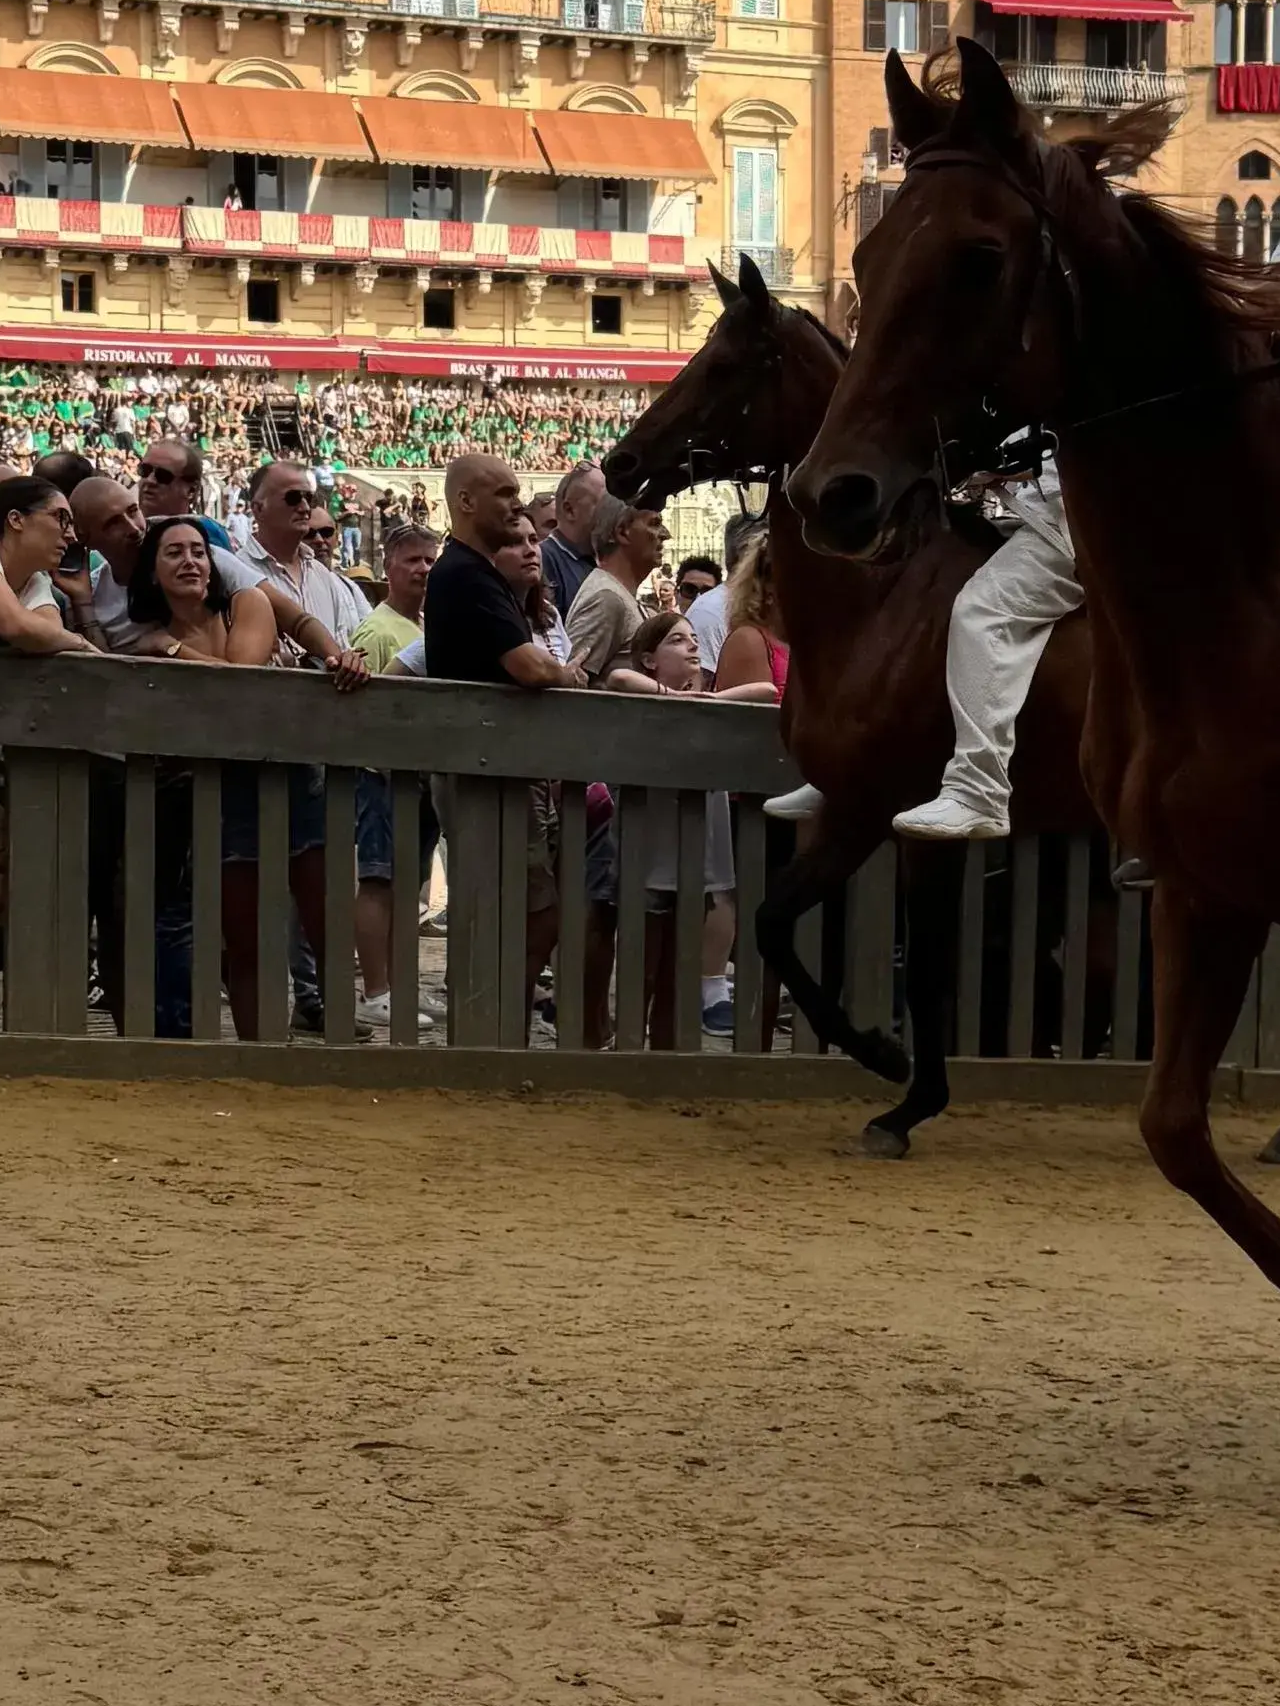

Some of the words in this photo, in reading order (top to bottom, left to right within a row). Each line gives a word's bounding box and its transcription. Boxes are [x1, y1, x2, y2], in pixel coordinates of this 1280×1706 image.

[84, 348, 173, 365] RISTORANTE
[184, 352, 204, 365] AL
[215, 353, 272, 367] MANGIA
[524, 365, 550, 378] BAR
[554, 366, 572, 379] AL
[576, 367, 627, 380] MANGIA
